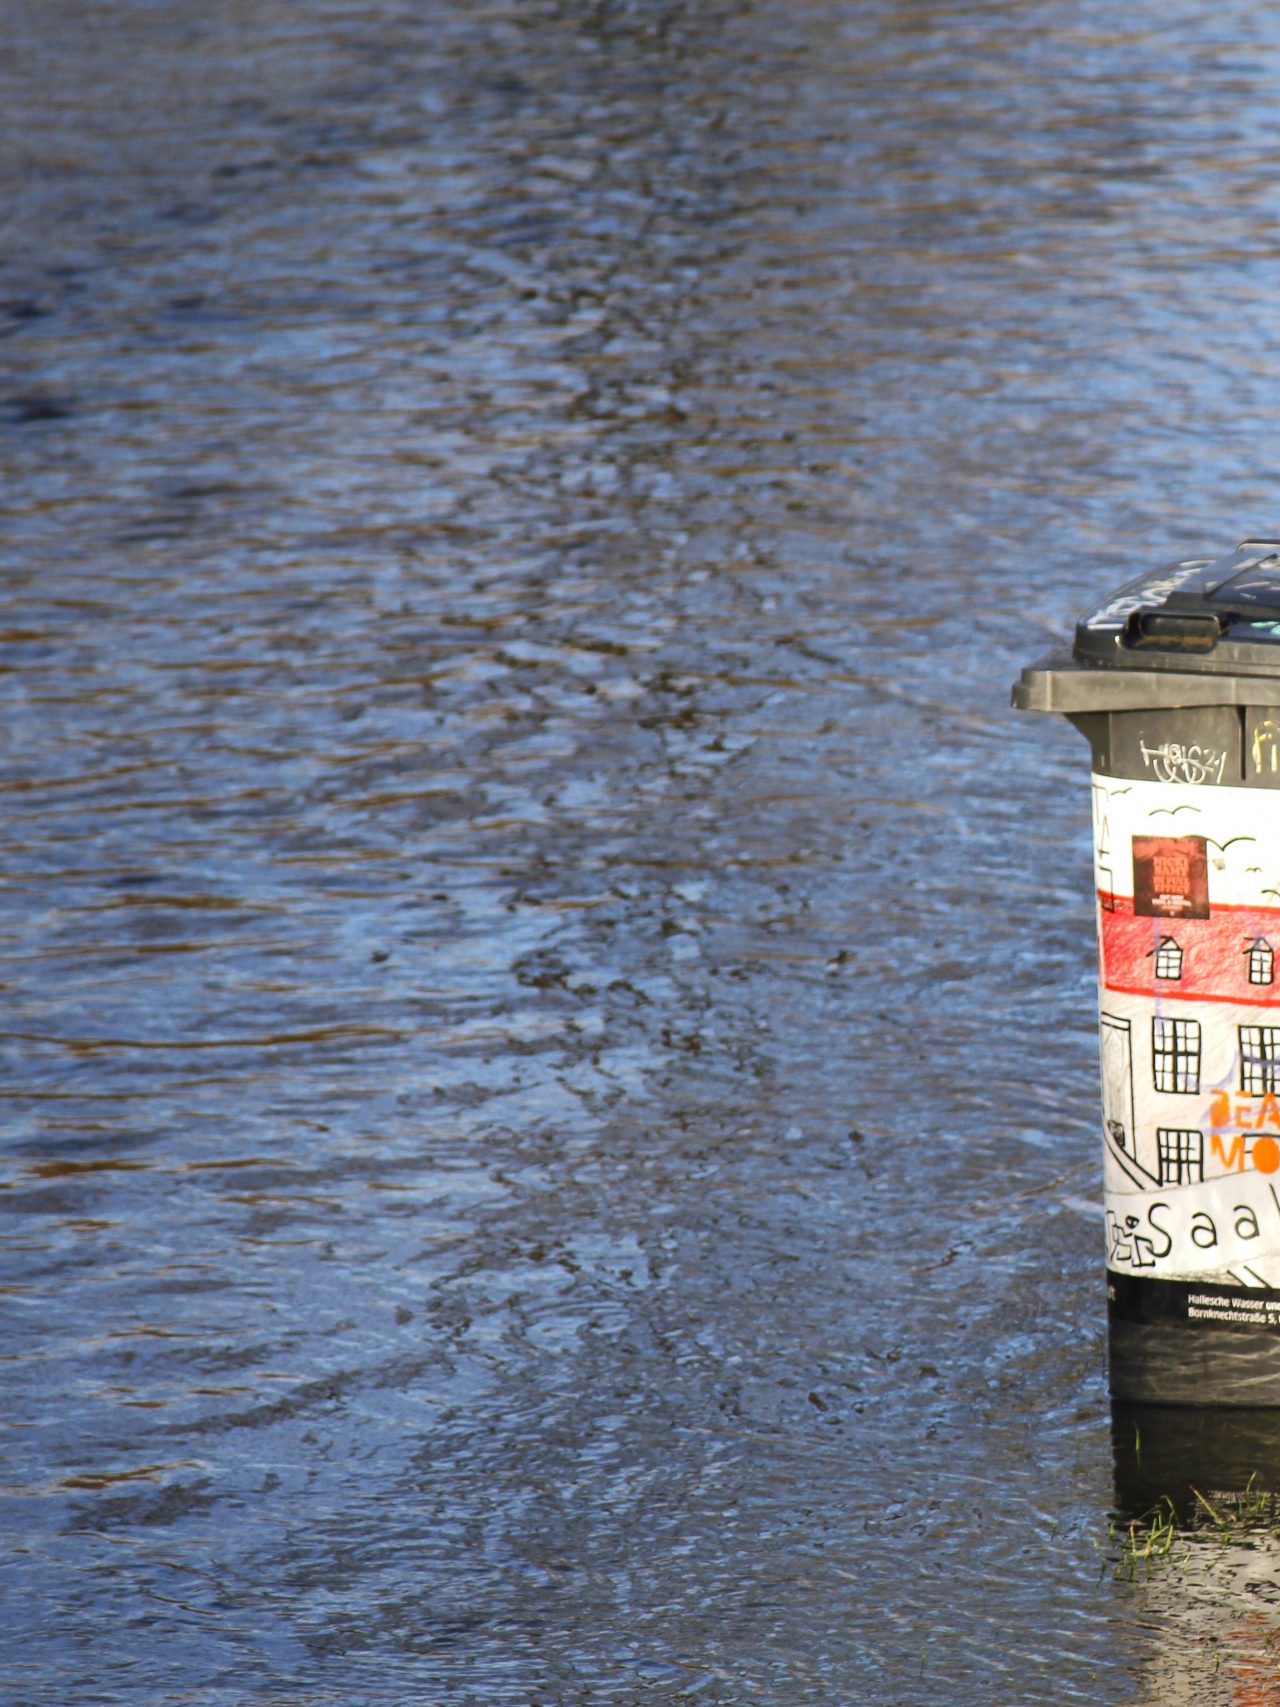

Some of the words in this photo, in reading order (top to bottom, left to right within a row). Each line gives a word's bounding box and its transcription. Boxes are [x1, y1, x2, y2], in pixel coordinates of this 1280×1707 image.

[1188, 1294, 1230, 1307] Hallesche
[1231, 1298, 1264, 1309] Wasser
[1268, 1313, 1277, 1325] 5,
